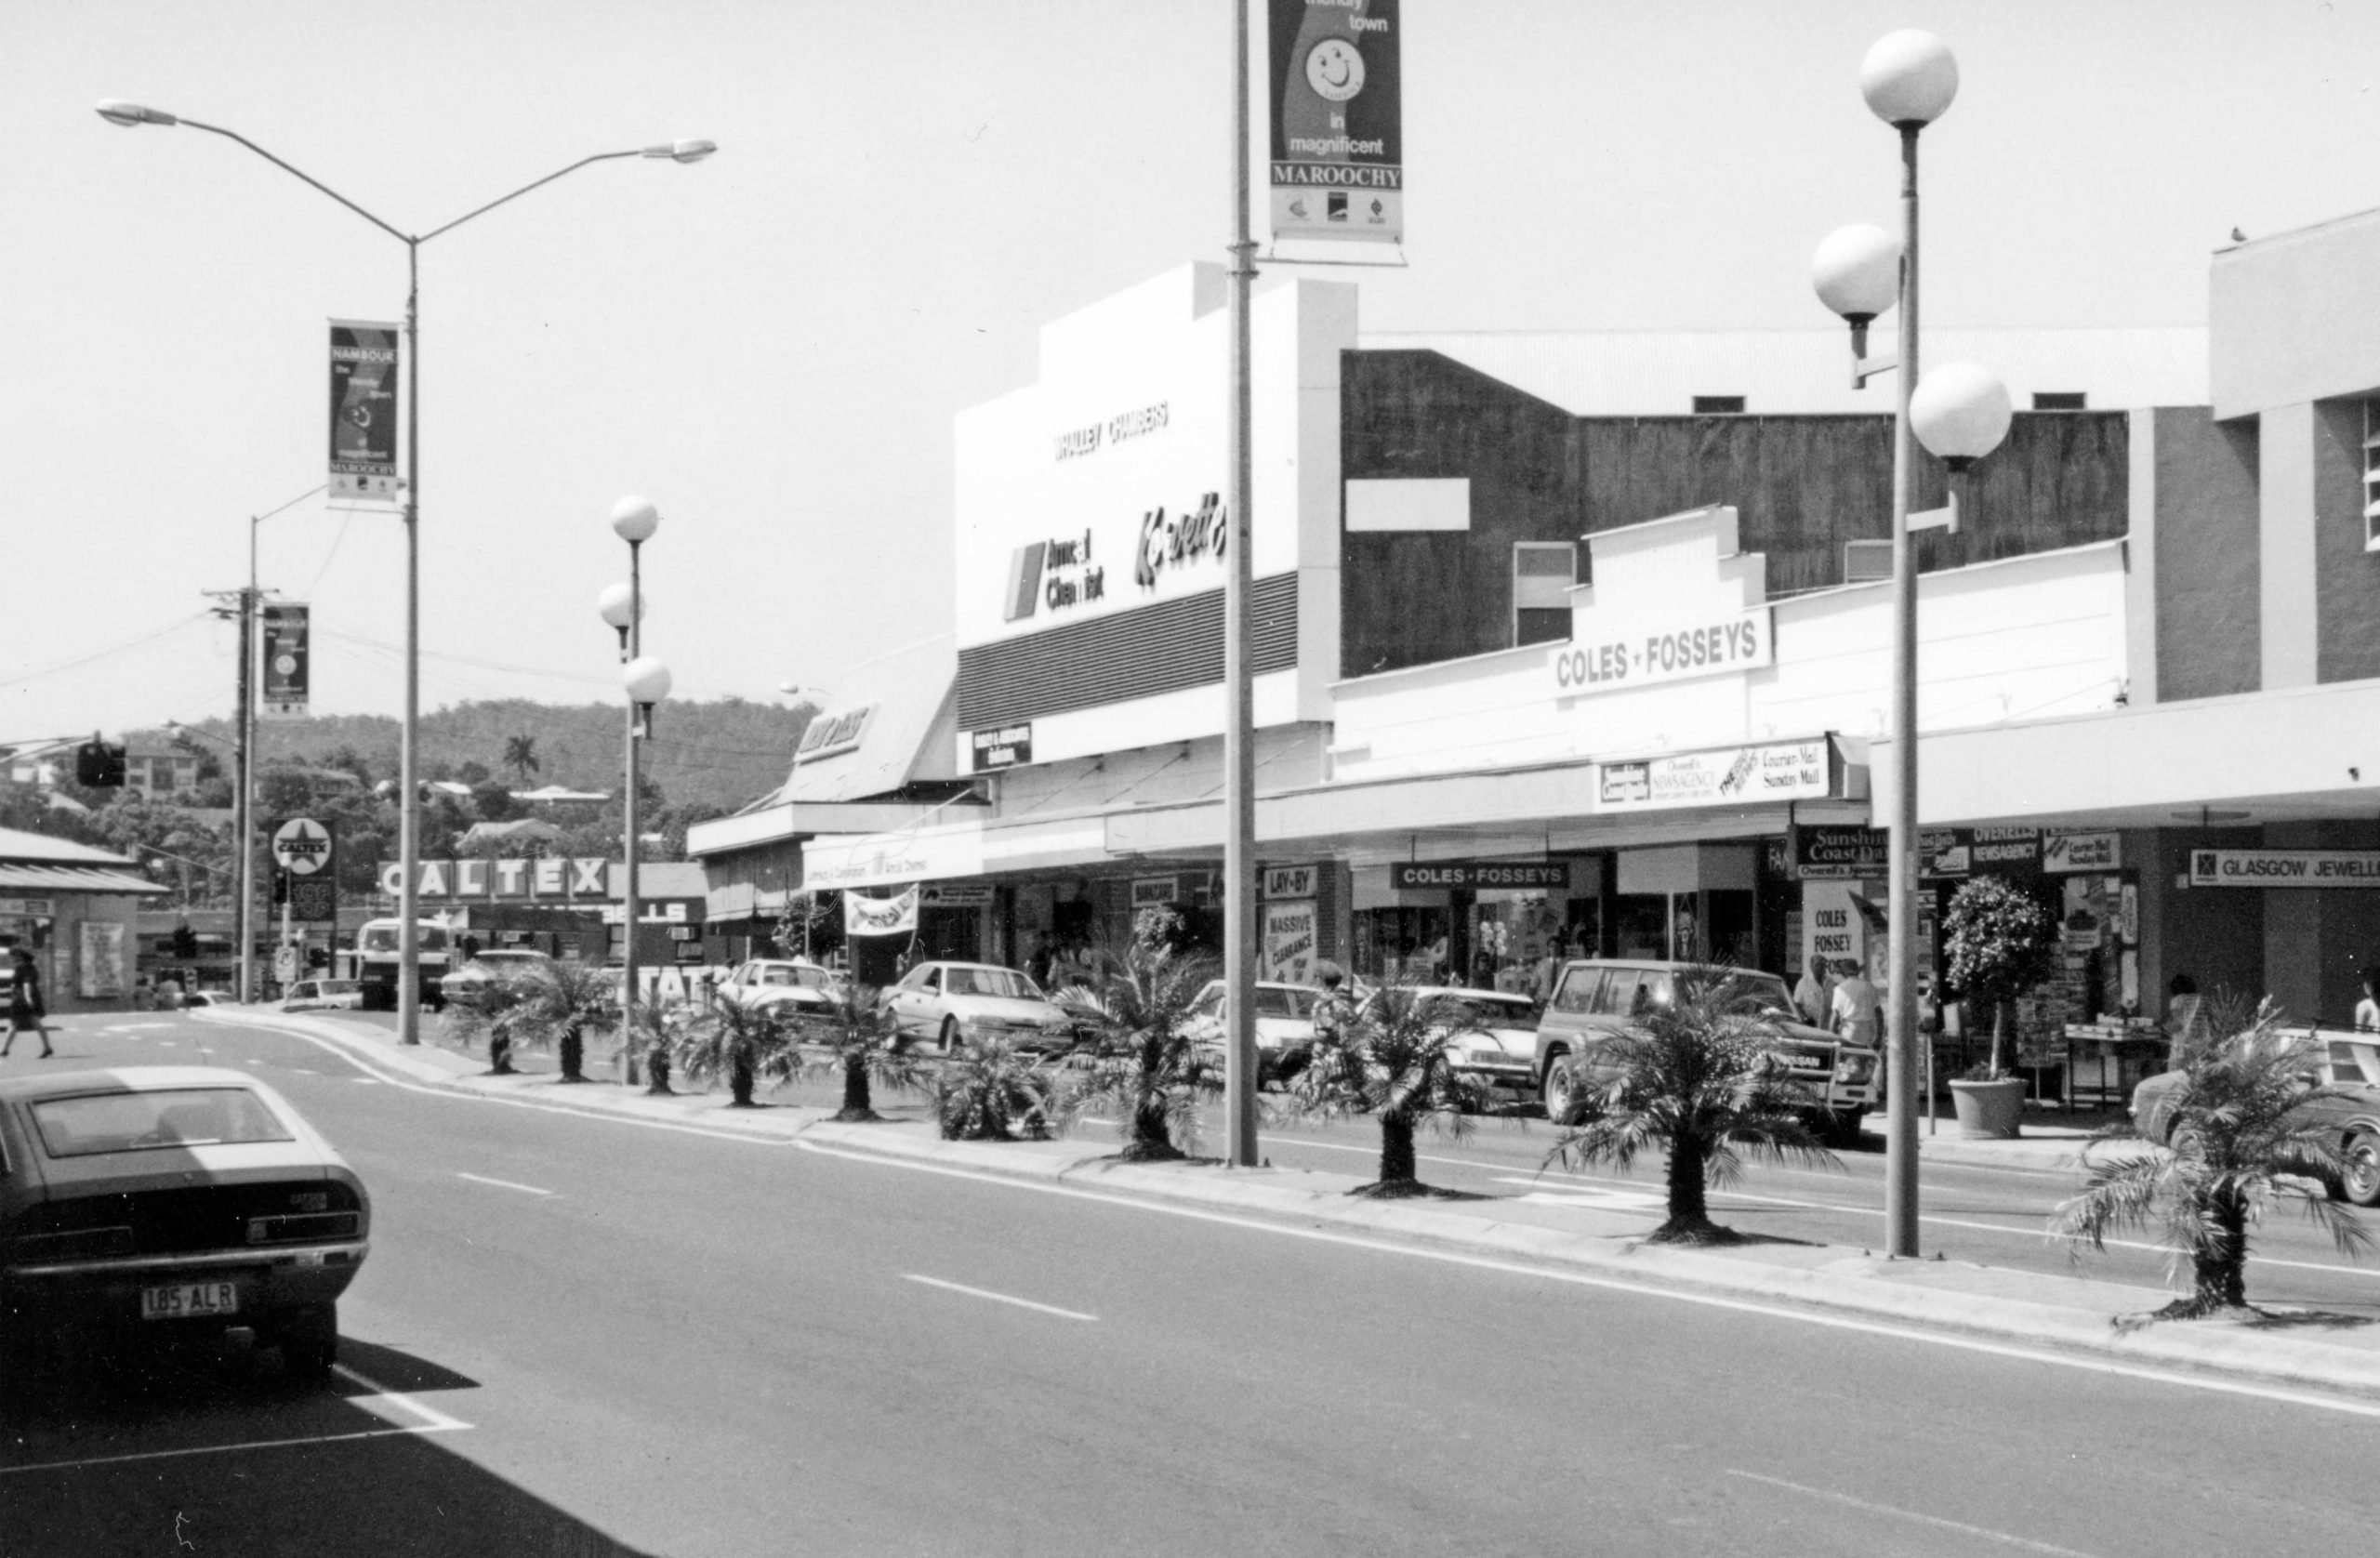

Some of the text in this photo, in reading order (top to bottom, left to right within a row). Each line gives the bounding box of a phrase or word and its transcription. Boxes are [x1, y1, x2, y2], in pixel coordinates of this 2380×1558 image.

[1349, 14, 1387, 32] town
[1330, 112, 1344, 128] in
[1290, 137, 1383, 155] magnificent
[1274, 165, 1401, 187] MAROOCHY
[332, 349, 395, 363] NAMBOUR
[1557, 619, 1757, 688] COLES FOSSEYS
[278, 842, 326, 853] CALTEX
[1809, 844, 1856, 861] Coast
[1973, 844, 2038, 861] NEWSAGENCY
[382, 858, 604, 895] CALTEX
[1404, 868, 1562, 883] COLES FOSSEYS
[2223, 860, 2380, 877] GLASGOW JEWELL
[1270, 870, 1310, 894] LAY-BY
[1270, 915, 1311, 934] MASSIVE
[1816, 910, 1847, 928] COLES
[1272, 932, 1313, 967] CLEARANCE
[1815, 934, 1852, 952] FOSSEY
[191, 1285, 232, 1309] ALR
